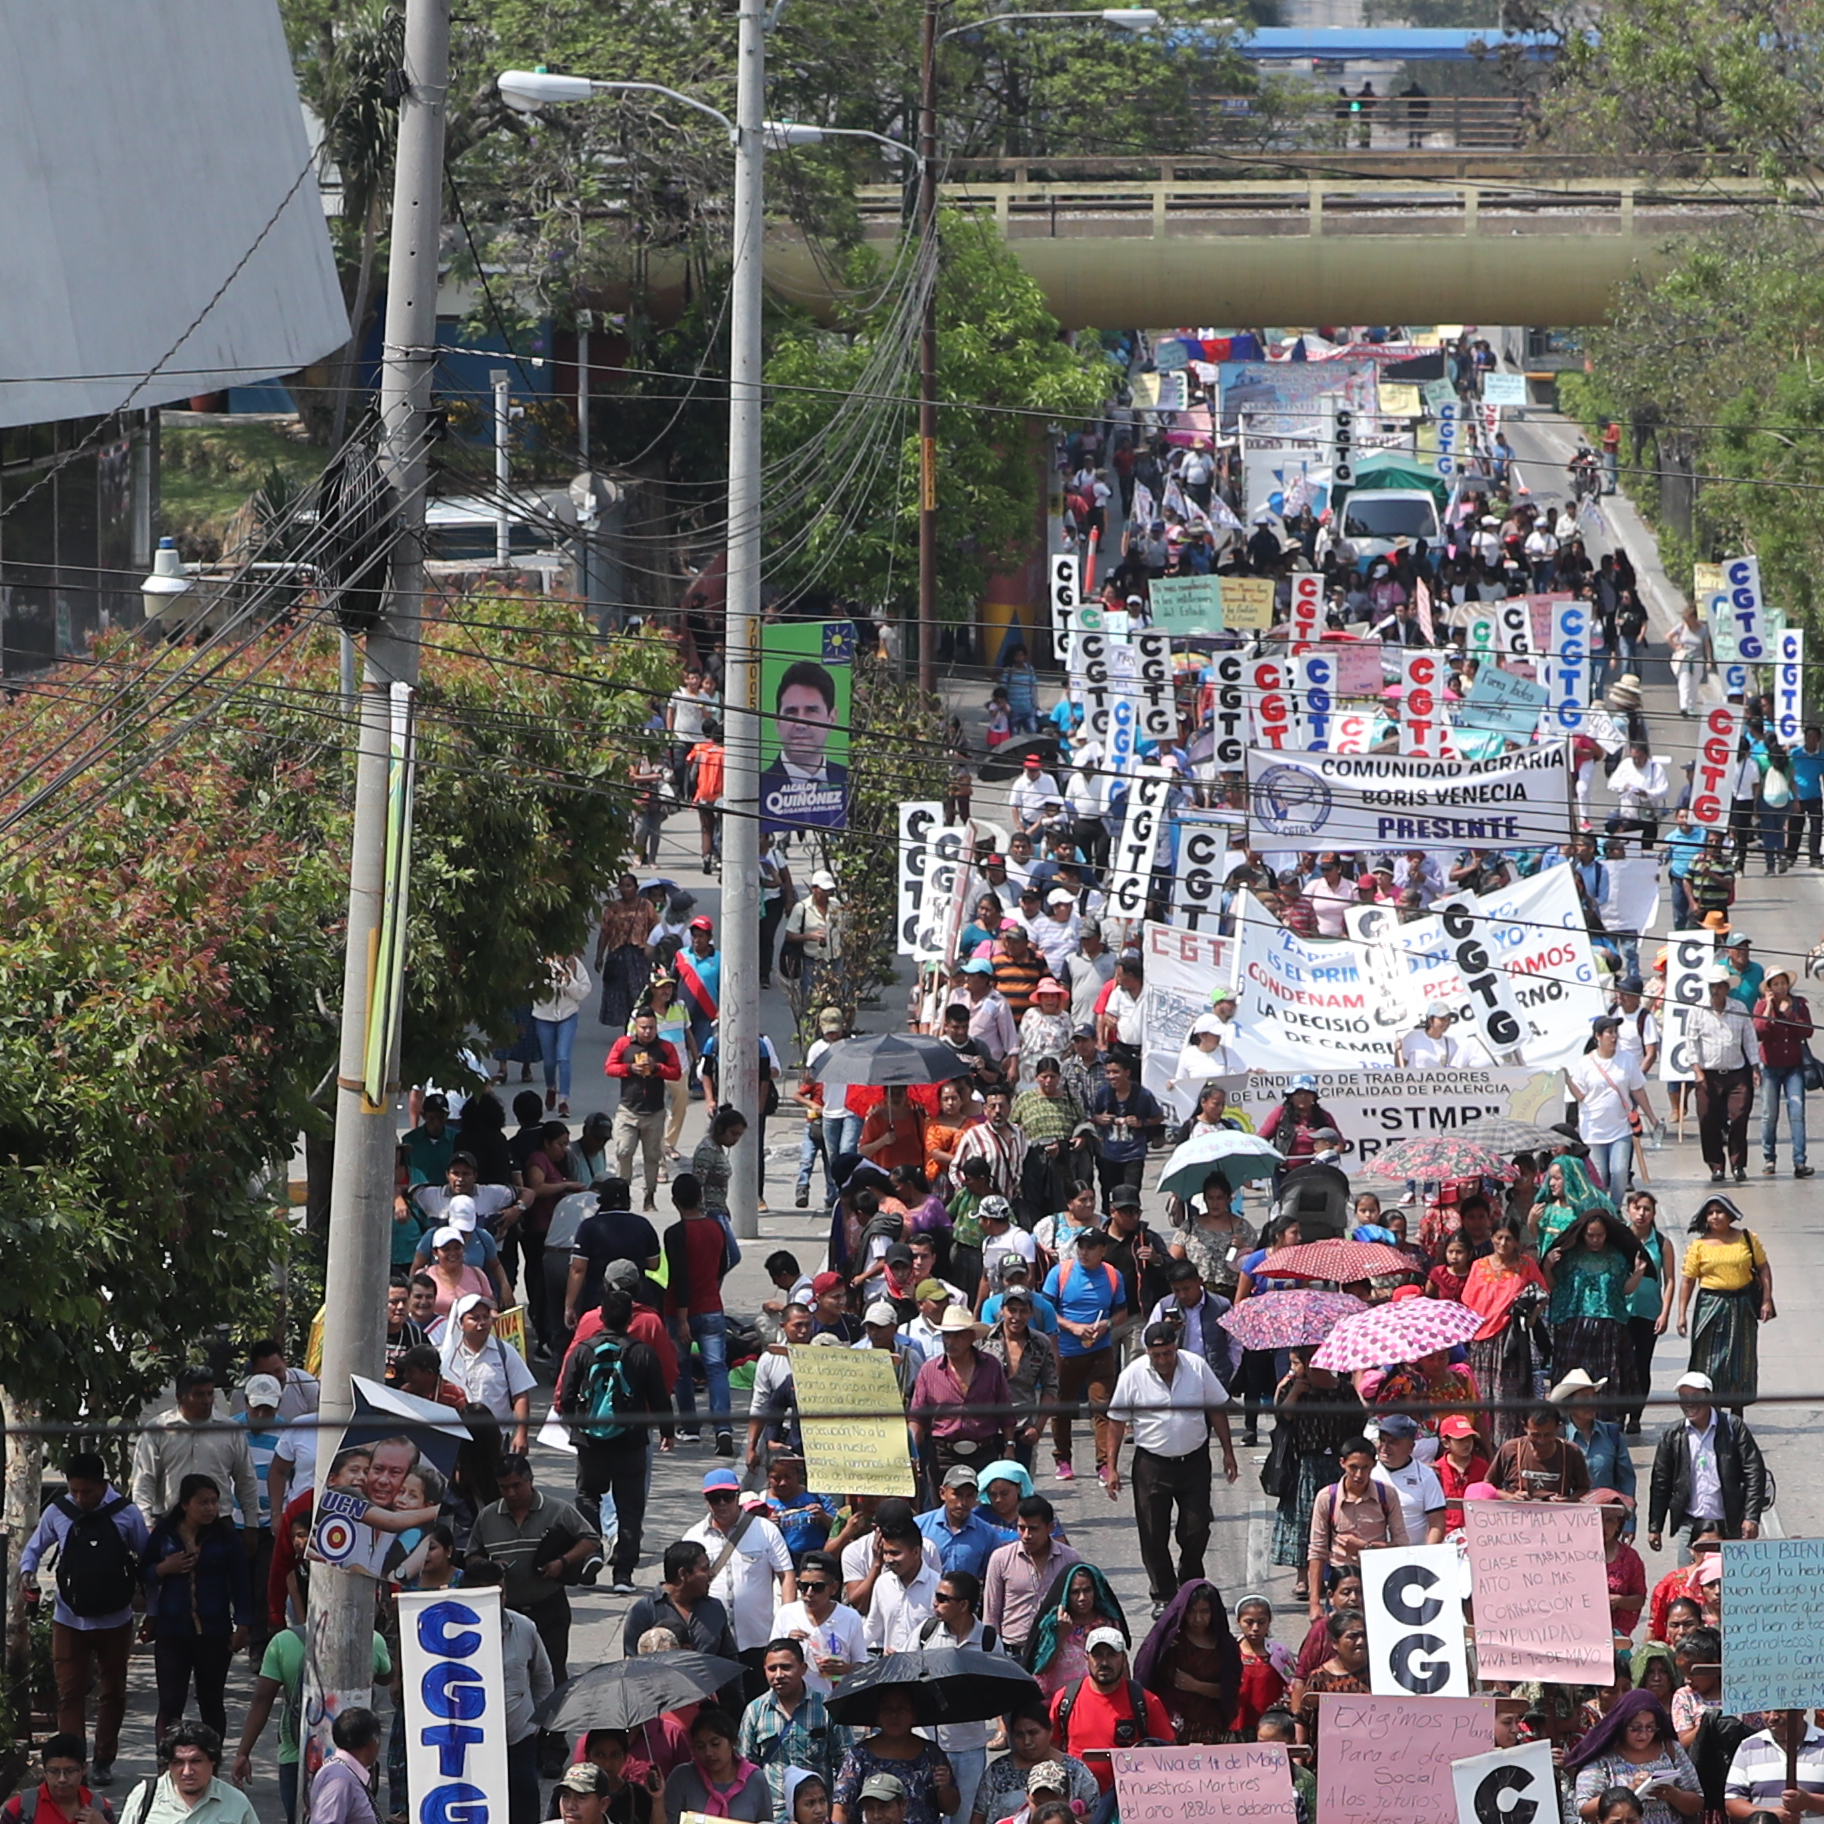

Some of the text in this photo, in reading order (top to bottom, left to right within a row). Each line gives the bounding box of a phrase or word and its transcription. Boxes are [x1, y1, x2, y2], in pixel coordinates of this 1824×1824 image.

[1335, 410, 1351, 481] CGTG
[1438, 404, 1455, 475] CGTG
[1728, 560, 1764, 660] CGTG
[1139, 635, 1169, 734] CGTG
[1217, 656, 1242, 762] CGTG
[1558, 606, 1585, 730] CGTG
[1781, 635, 1798, 737] CGTG
[1321, 749, 1564, 779] COMUNIDAD AGRARIA
[1435, 783, 1527, 805] VENECIA
[1693, 708, 1735, 824] CGTG
[1119, 775, 1161, 911] CGTG
[1377, 816, 1519, 840] PRESENTE
[1442, 903, 1521, 1044] CGTG
[1231, 1090, 1253, 1103] DE
[1257, 1089, 1276, 1101] LA
[1432, 1083, 1511, 1096] PALENCIA
[1249, 1071, 1490, 1088] SINDITO DE TRABAJADORES
[320, 1489, 369, 1520] UCN
